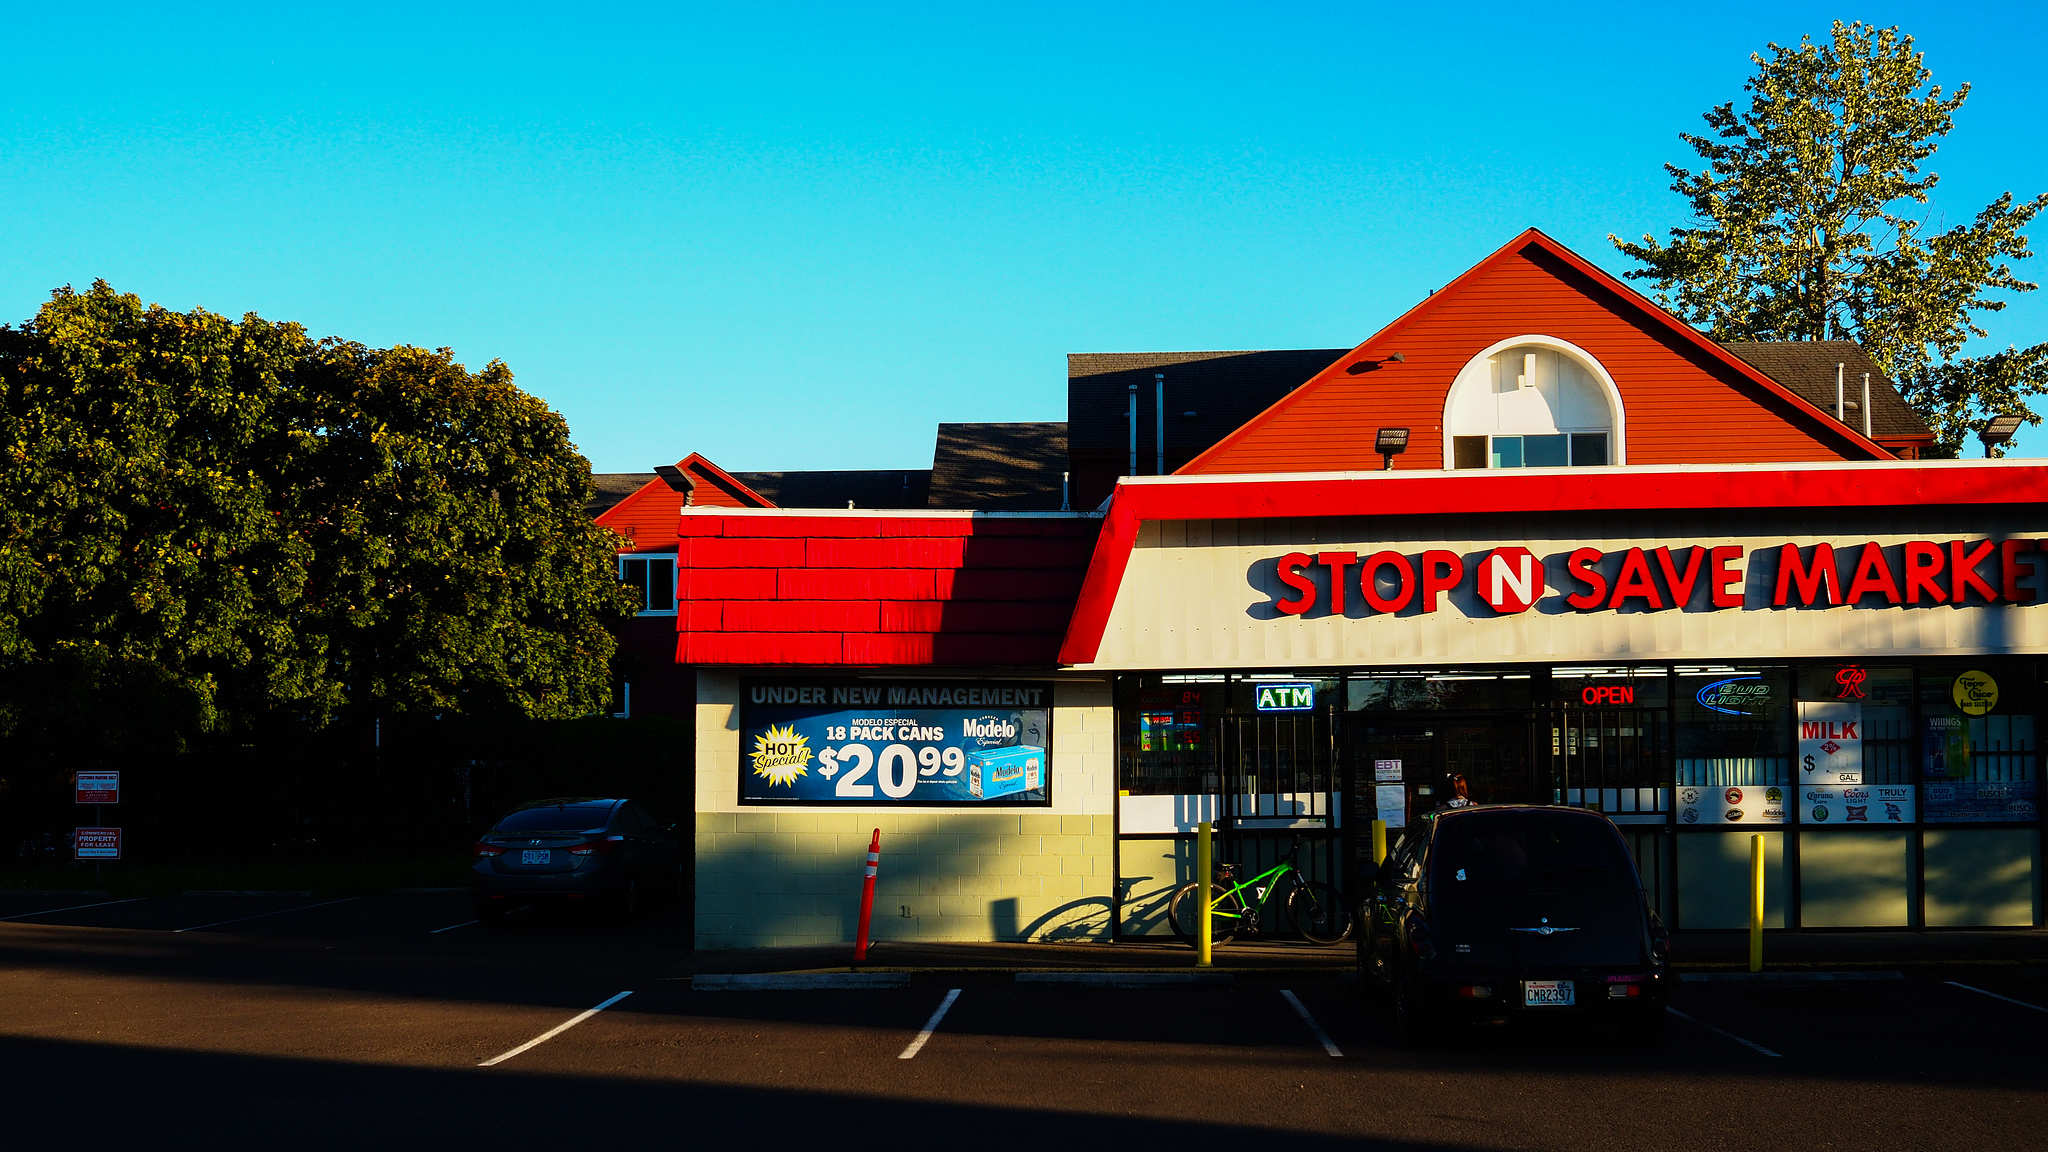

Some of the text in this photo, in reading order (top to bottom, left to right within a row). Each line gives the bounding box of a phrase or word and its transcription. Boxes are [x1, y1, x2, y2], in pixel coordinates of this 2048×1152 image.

[1275, 538, 2047, 615] STOP N SAVE MARKE
[1719, 683, 1771, 695] BUD
[1959, 677, 1986, 690] Topo
[751, 686, 1044, 705] UNDER NEW MANAGEMENT
[1259, 688, 1311, 707] ATM
[1581, 686, 1634, 705] OPEN
[1705, 693, 1773, 706] LIGHT
[1968, 688, 1995, 701] Chico
[852, 718, 918, 726] MODELO ESPECIAL
[963, 718, 1016, 738] Modelo
[826, 726, 944, 741] 18 PACK CANS
[1802, 721, 1858, 739] MILK
[765, 743, 798, 755] HOT
[755, 749, 810, 771] Special!
[1376, 760, 1401, 770] EBT
[1803, 754, 1815, 775] $
[995, 765, 1020, 778] Modelo
[1806, 791, 1834, 801] Corona
[1843, 788, 1869, 798] Coors
[1878, 788, 1907, 796] TRULY
[1978, 790, 2004, 798] BUSCH
[2008, 804, 2034, 812] BUSCH
